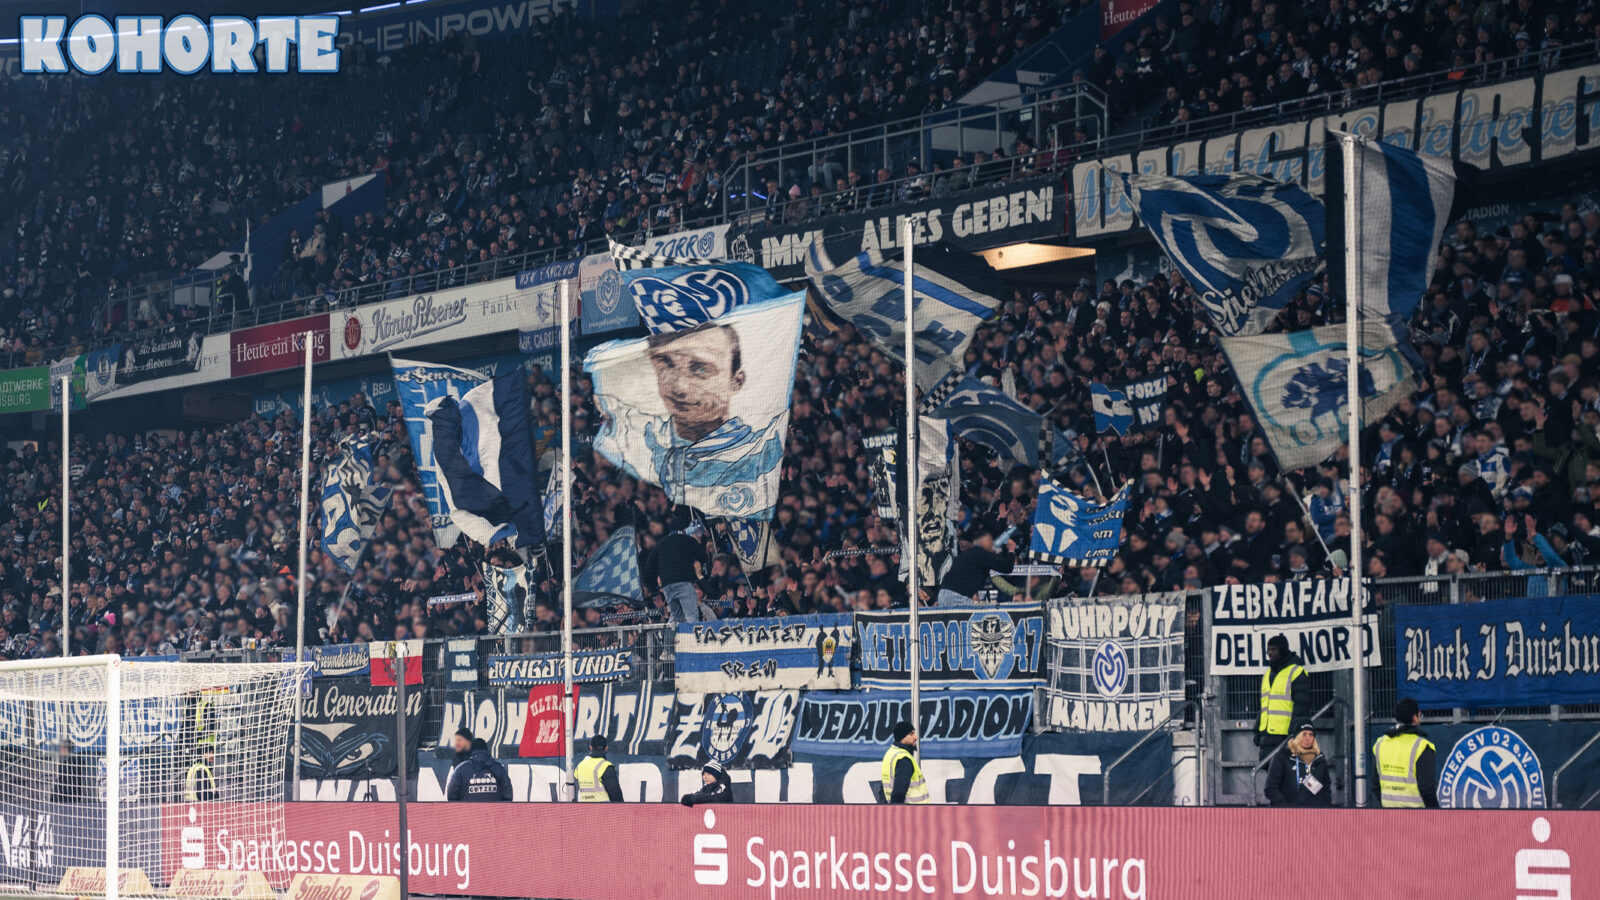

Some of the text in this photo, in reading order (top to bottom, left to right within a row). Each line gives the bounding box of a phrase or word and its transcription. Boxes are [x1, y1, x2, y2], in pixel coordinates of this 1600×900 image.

[1104, 10, 1136, 27] Heute
[861, 209, 944, 251] ALLES
[952, 186, 1054, 238] GEBEN!
[236, 340, 270, 363] Heute
[272, 338, 289, 356] ein
[1013, 615, 1044, 673] 47
[1404, 625, 1471, 683] Block
[720, 658, 778, 680] CREW
[1050, 696, 1171, 732] KANAKEN
[1467, 732, 1485, 751] SV
[1491, 731, 1511, 748] 02
[216, 828, 339, 875] Sparkasse
[349, 829, 470, 891] Duisburg
[746, 835, 937, 900] Sparkasse
[950, 839, 1147, 900] Duisburg
[294, 875, 353, 900] Sinalco
